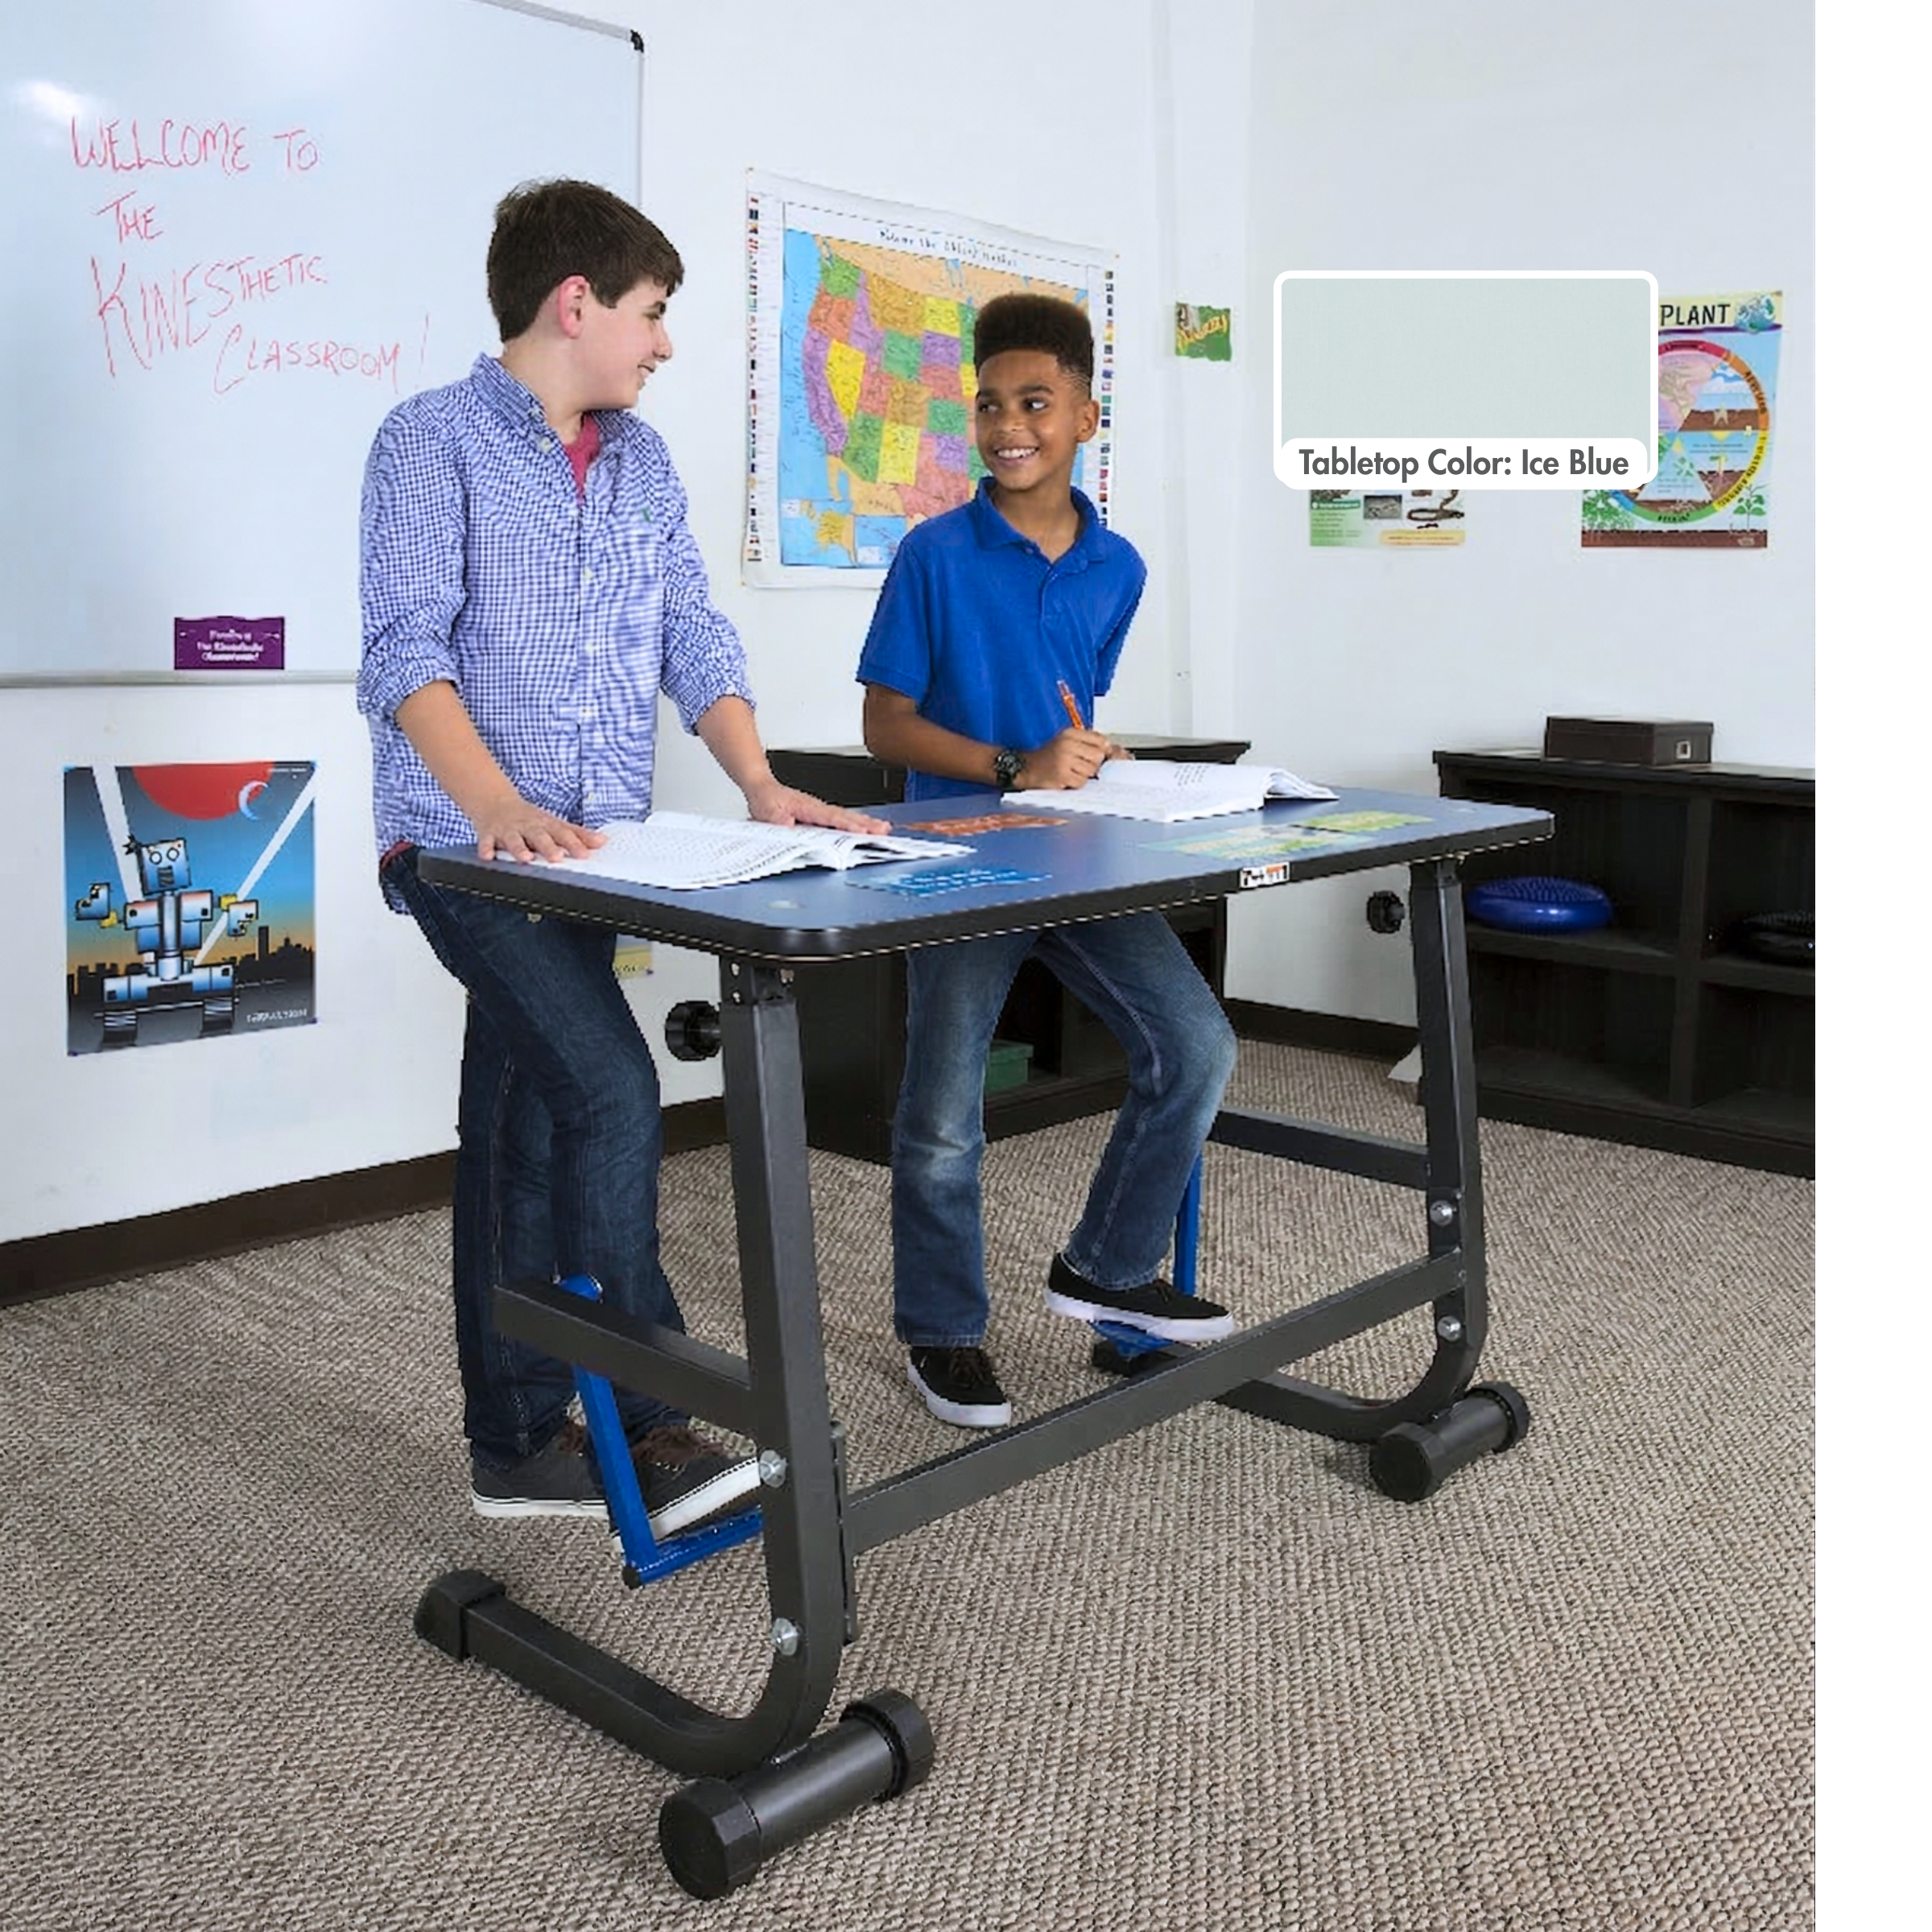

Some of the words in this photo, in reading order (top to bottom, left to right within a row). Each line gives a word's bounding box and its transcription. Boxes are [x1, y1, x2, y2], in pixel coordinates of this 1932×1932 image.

[72, 117, 250, 175] WELCOME
[273, 130, 318, 171] TO
[97, 191, 163, 243] THE
[91, 254, 327, 378] KINESTHETIC
[1660, 304, 1731, 326] PLANT
